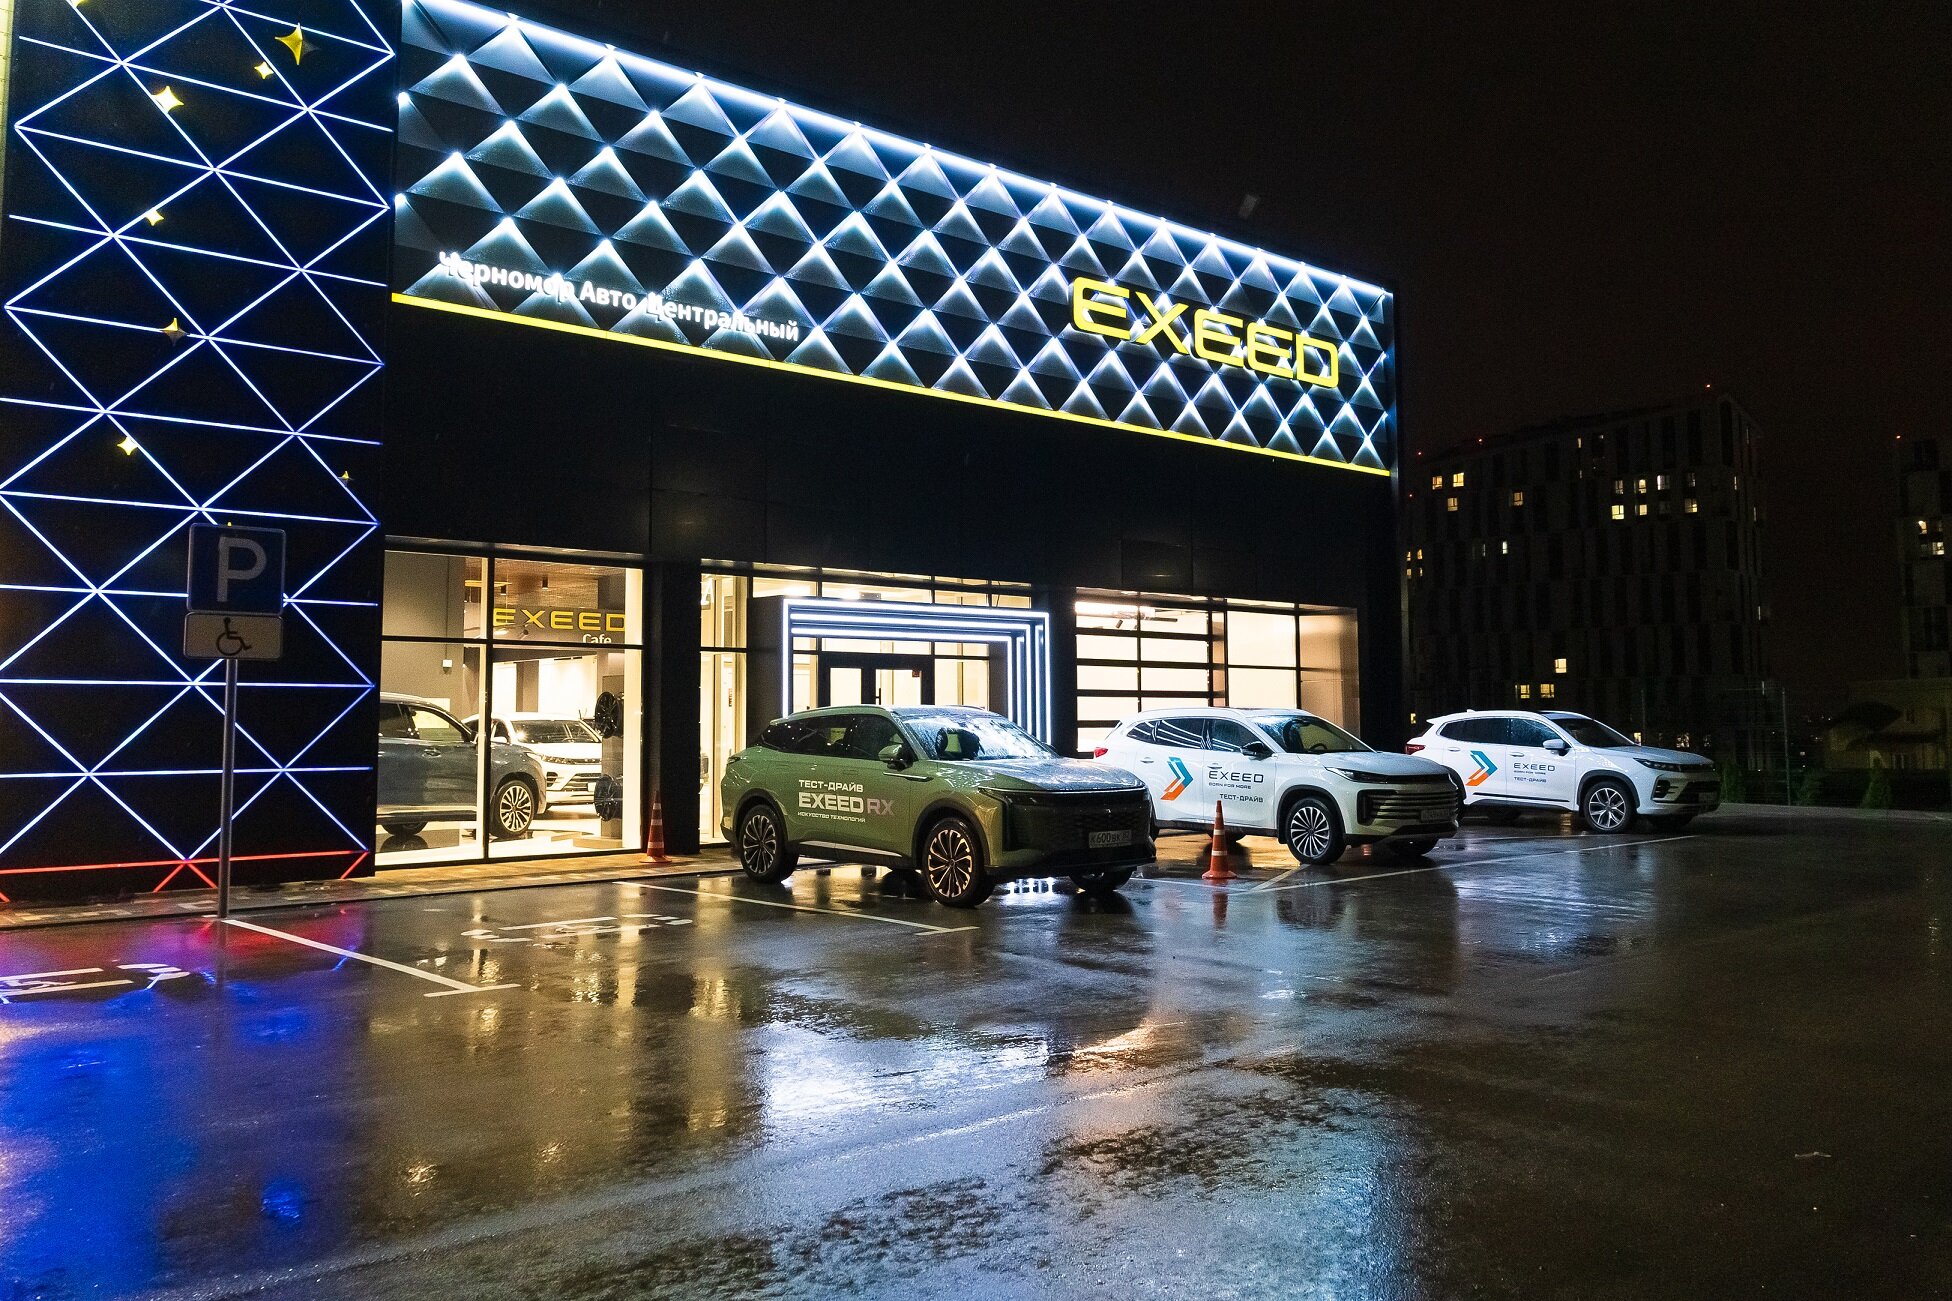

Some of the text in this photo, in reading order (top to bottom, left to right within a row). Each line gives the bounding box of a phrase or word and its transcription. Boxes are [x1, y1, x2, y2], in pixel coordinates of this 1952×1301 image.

[439, 251, 800, 341] Черномор Авто Центральный
[1073, 276, 1339, 388] EXEED
[217, 536, 267, 603] P
[493, 608, 625, 632] EXEED
[1208, 770, 1264, 783] EXEED
[1514, 763, 1555, 771] EXEED
[799, 779, 864, 792] ТЕСТ-ДРАЙВ
[798, 792, 894, 816] EXEED RX
[1219, 793, 1264, 803] ТЕСТ-ДРАЙВ
